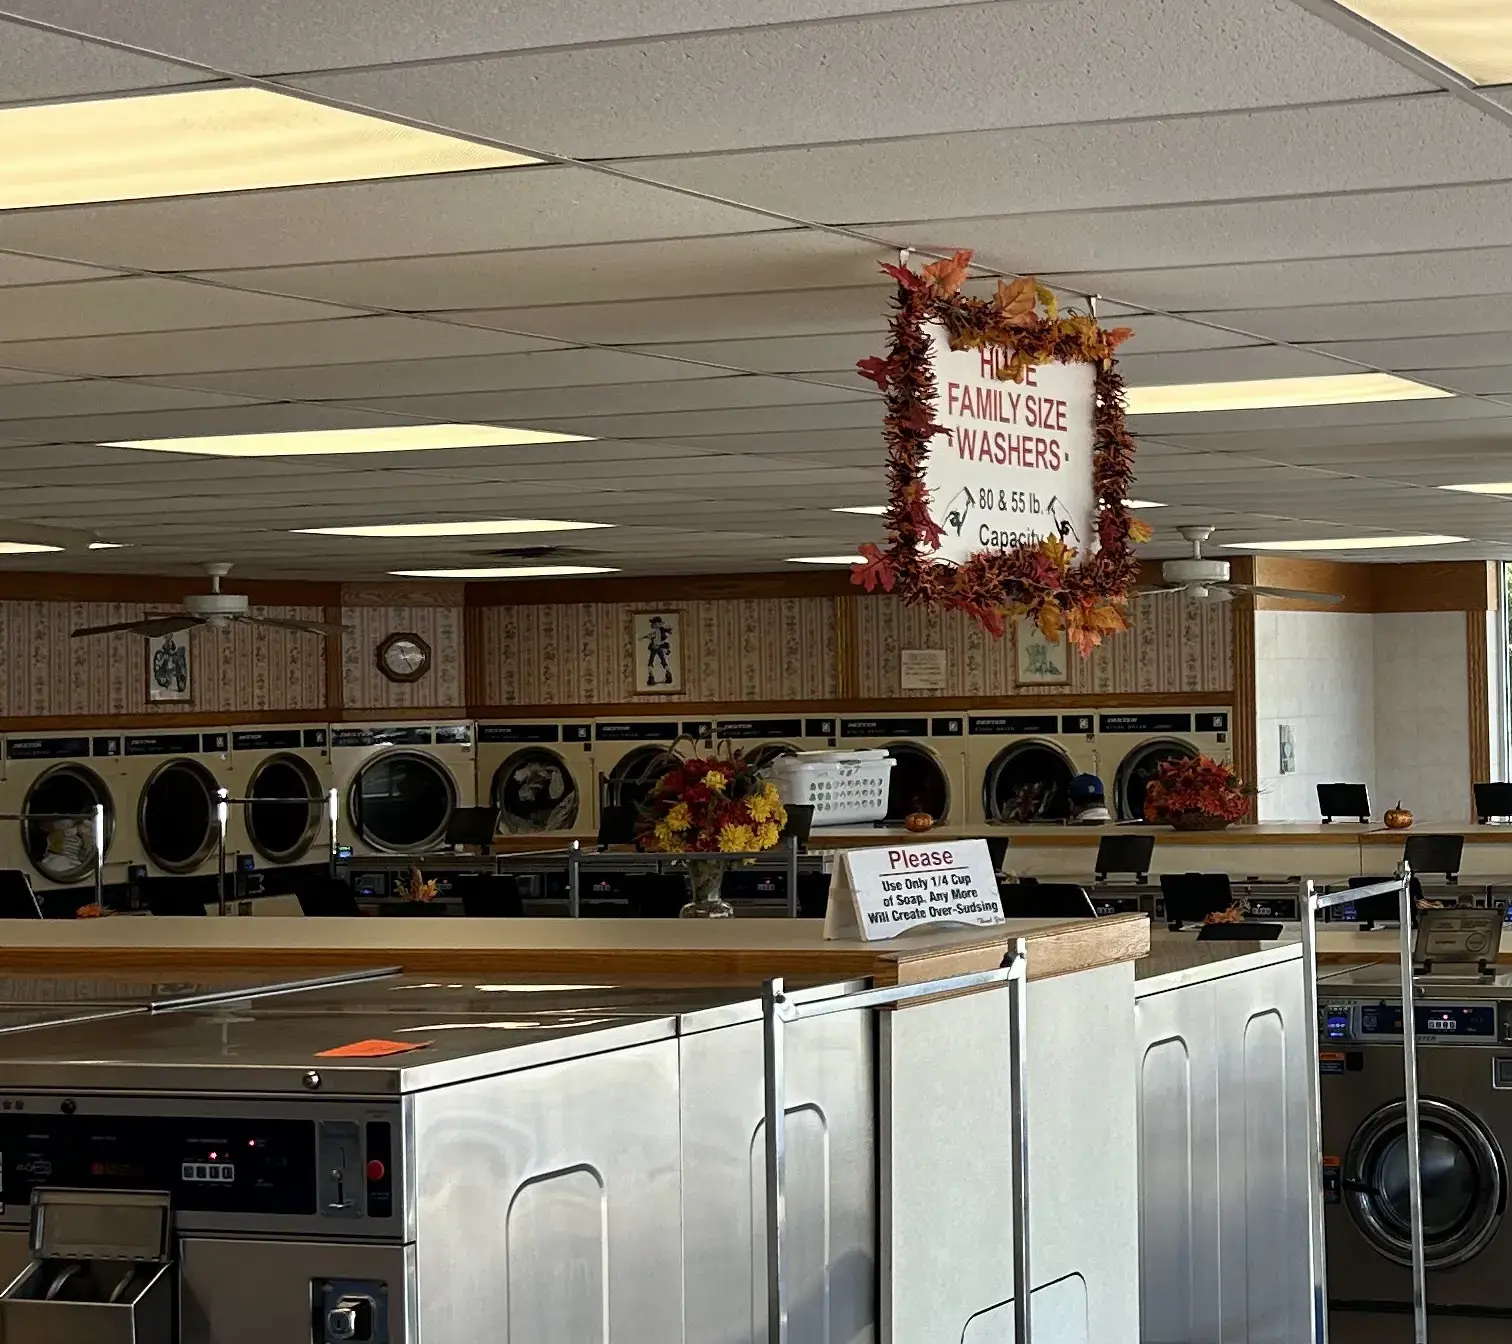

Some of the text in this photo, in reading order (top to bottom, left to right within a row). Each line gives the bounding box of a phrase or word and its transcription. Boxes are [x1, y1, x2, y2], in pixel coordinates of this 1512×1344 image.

[980, 346, 1038, 387] HUE
[948, 381, 1068, 432] FAMILY SIZE
[956, 426, 1061, 472] WASHERS
[979, 487, 1044, 515] 80 & 55 lb.
[888, 849, 954, 870] Please
[882, 873, 972, 892] Use Only 1/4 Cup
[883, 888, 978, 907] of Soap. Any More
[867, 901, 998, 925] Will Create Over-Sudsing
